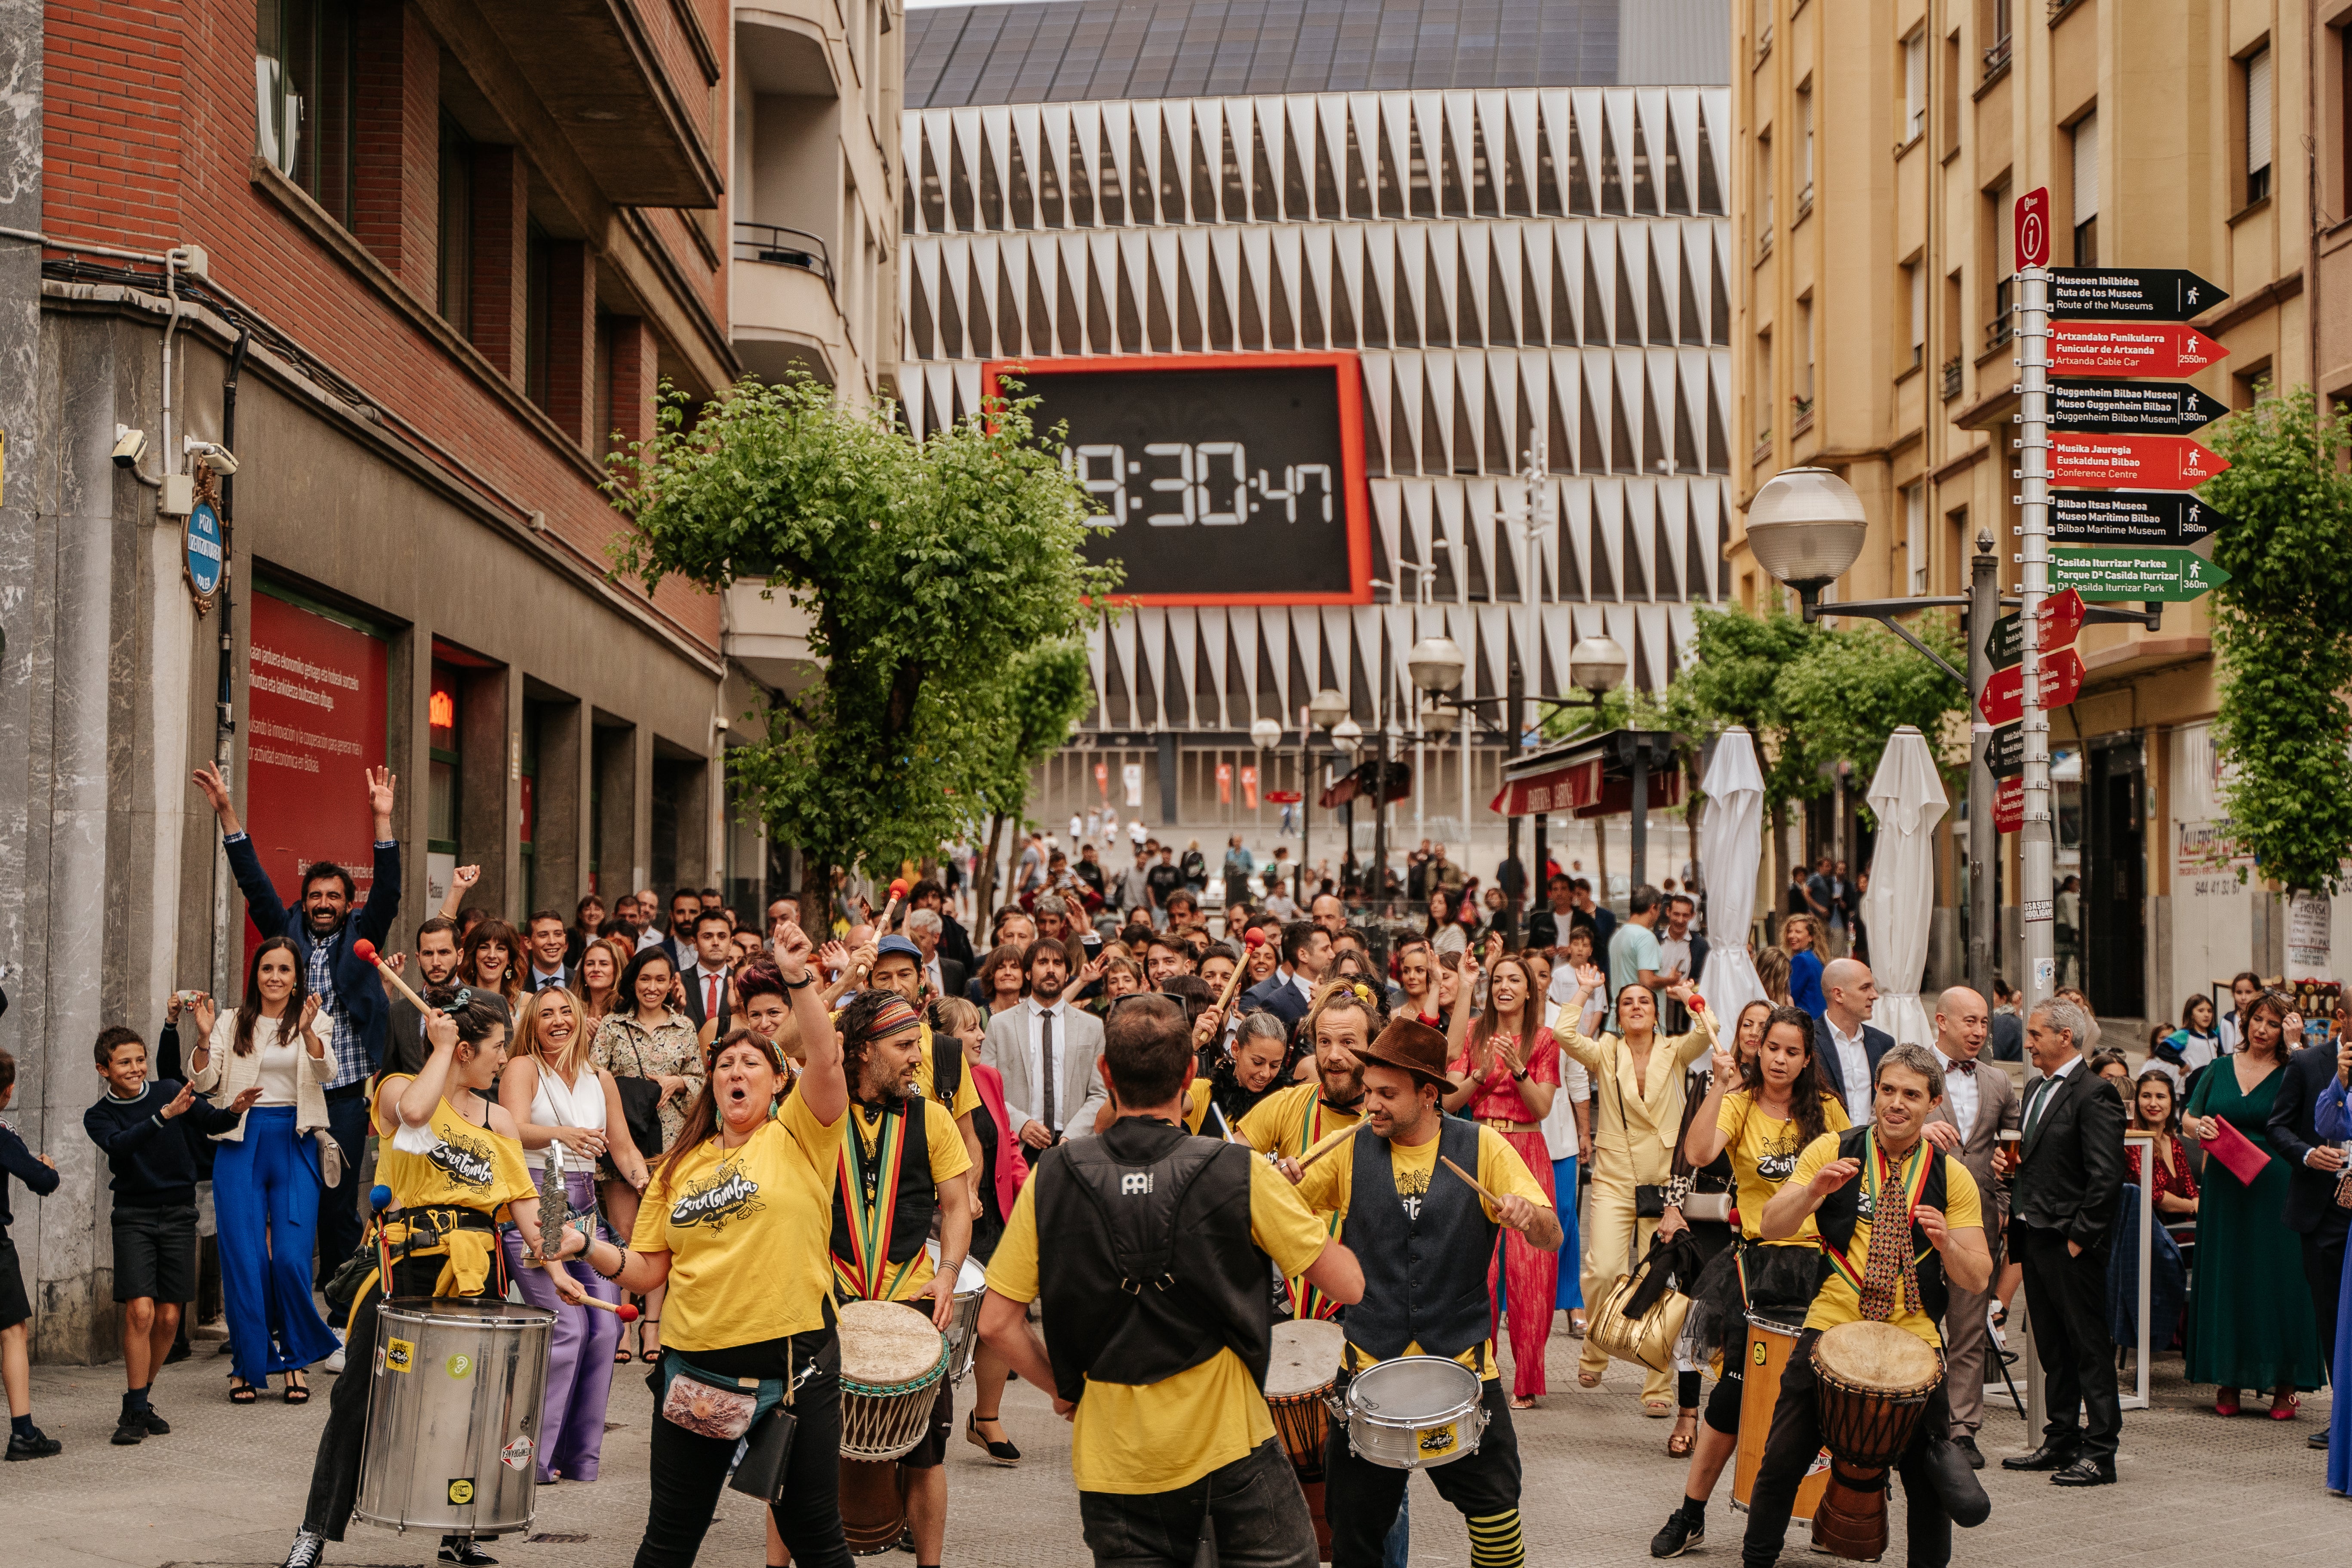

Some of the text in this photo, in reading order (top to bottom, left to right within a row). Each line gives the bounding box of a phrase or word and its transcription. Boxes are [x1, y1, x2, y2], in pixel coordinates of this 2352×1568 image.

[2056, 277, 2139, 286] Museoen Ibilbidea
[2056, 288, 2143, 298] Ruta de los Museos
[2056, 300, 2153, 310] Route of the Museums
[2056, 332, 2164, 343] Artxandako Funikularra
[2056, 344, 2155, 355] Funicular de Artxanda
[2056, 357, 2140, 367] Artxanda Cable Car
[2180, 355, 2207, 364] 2550m
[2056, 387, 2177, 399] Guggenheim Bilbao Museoa
[2056, 399, 2171, 411] Museo Guggenheim Bilbao
[2056, 412, 2177, 423] Guggenheim Bilbao Museum
[2180, 413, 2207, 422] 1380m
[2056, 444, 2131, 456] Musika Jauregia
[2056, 456, 2140, 467] Euskalduna Bilbao
[2056, 468, 2137, 479] Conference Centre
[2183, 468, 2207, 476] 430m
[2056, 499, 2147, 510] Bilbao Itsas Museoa
[2056, 512, 2160, 523] Museo Marítimo Bilbao
[199, 513, 212, 535] POZA
[2183, 524, 2207, 532] 380m
[2057, 524, 2166, 536] Bilbao Maritime Museum
[2056, 558, 2167, 568] Casilda Iturrizar Parkea
[197, 573, 210, 590] KALEA
[2057, 571, 2090, 581] Parque
[2104, 571, 2138, 580] Casilda
[2140, 571, 2179, 580] Iturrizar
[2072, 582, 2103, 591] Casilda
[2106, 583, 2142, 592] Iturrizar
[2144, 584, 2164, 592] Park
[2184, 580, 2208, 588] 360m
[262, 645, 280, 667] jarduera
[276, 676, 298, 699] lankidetza
[267, 718, 272, 736] la
[272, 720, 295, 741] innovación
[254, 745, 274, 764] actividad
[274, 749, 298, 768] económica
[2025, 909, 2053, 918] HOOLIGANS
[459, 1174, 483, 1186] BATUKADA
[715, 1200, 744, 1214] BATUKADA
